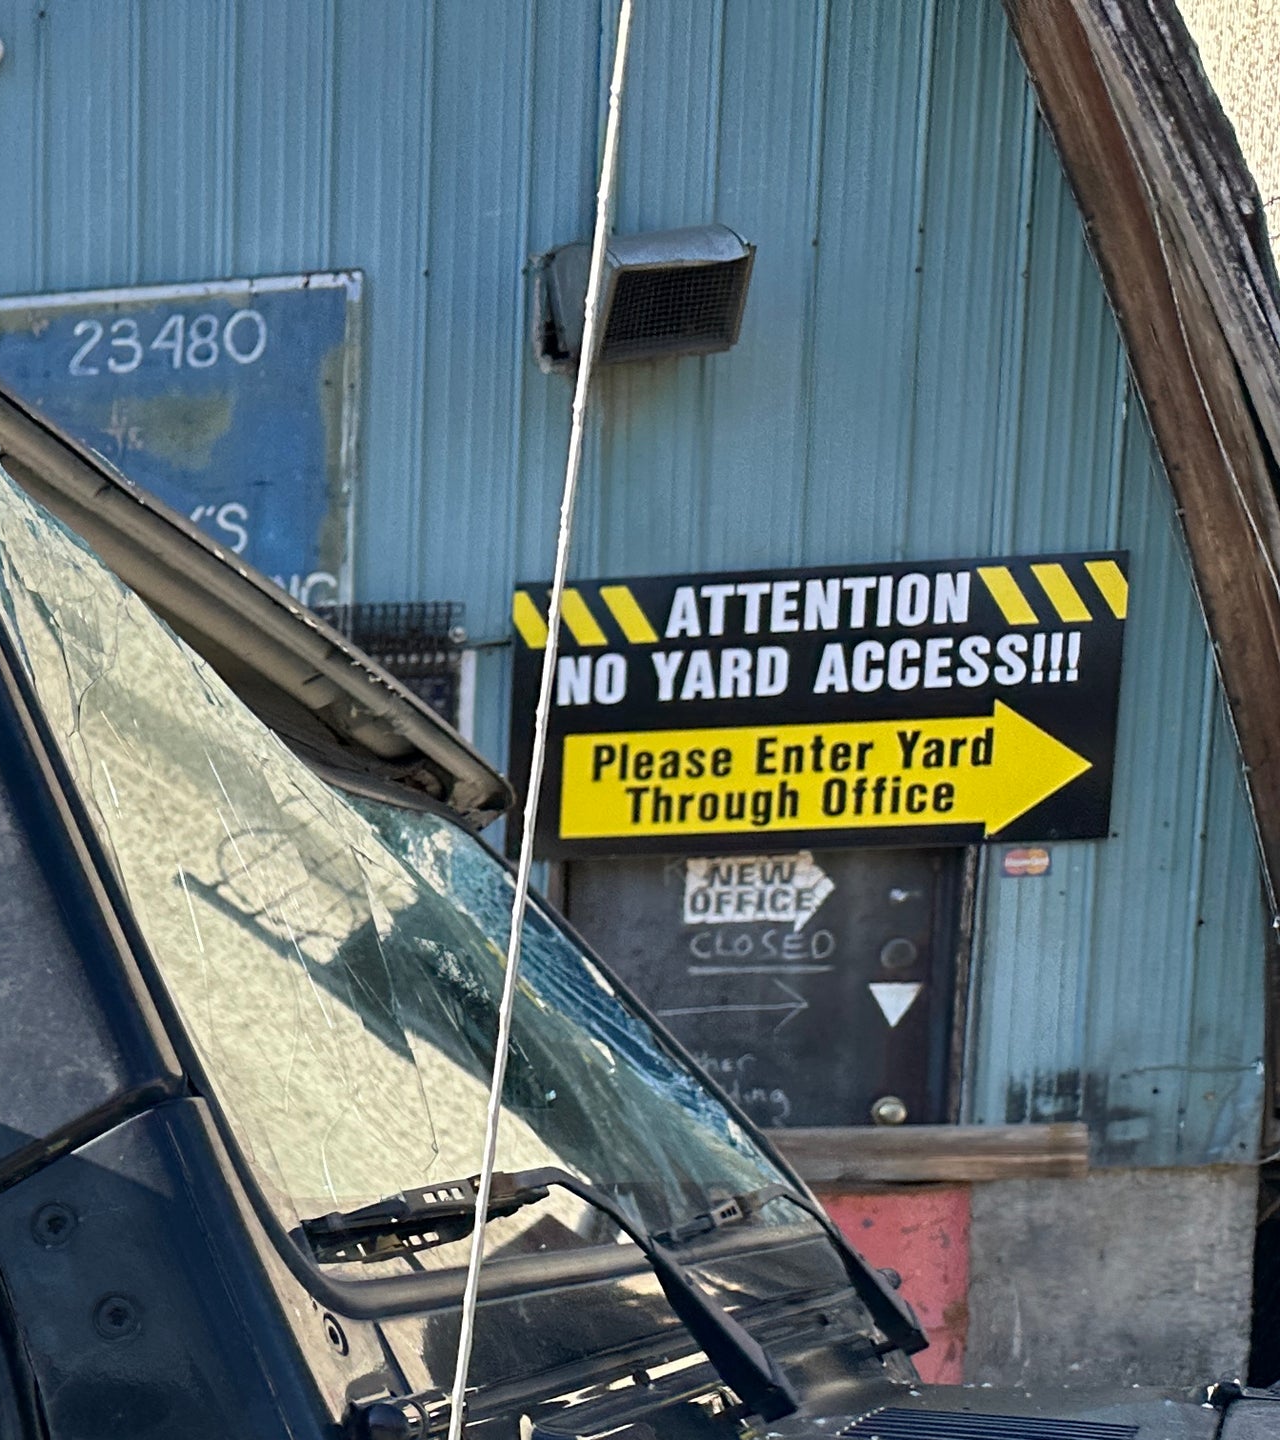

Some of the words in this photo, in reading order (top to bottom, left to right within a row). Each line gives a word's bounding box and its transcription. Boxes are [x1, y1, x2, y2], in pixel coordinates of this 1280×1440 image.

[68, 309, 267, 376] 23480
[665, 572, 971, 639] ATTENTION
[556, 652, 627, 706] NO
[651, 645, 789, 702] YARD
[813, 631, 1081, 694] ACCESS!!!
[592, 743, 733, 782] Please
[756, 734, 874, 775] Enter
[897, 727, 994, 770] Yard
[626, 781, 799, 826] Through
[823, 776, 955, 817] Office
[708, 861, 797, 886] NEW
[691, 887, 815, 914] OFFICE
[691, 929, 836, 960] CLOSED
